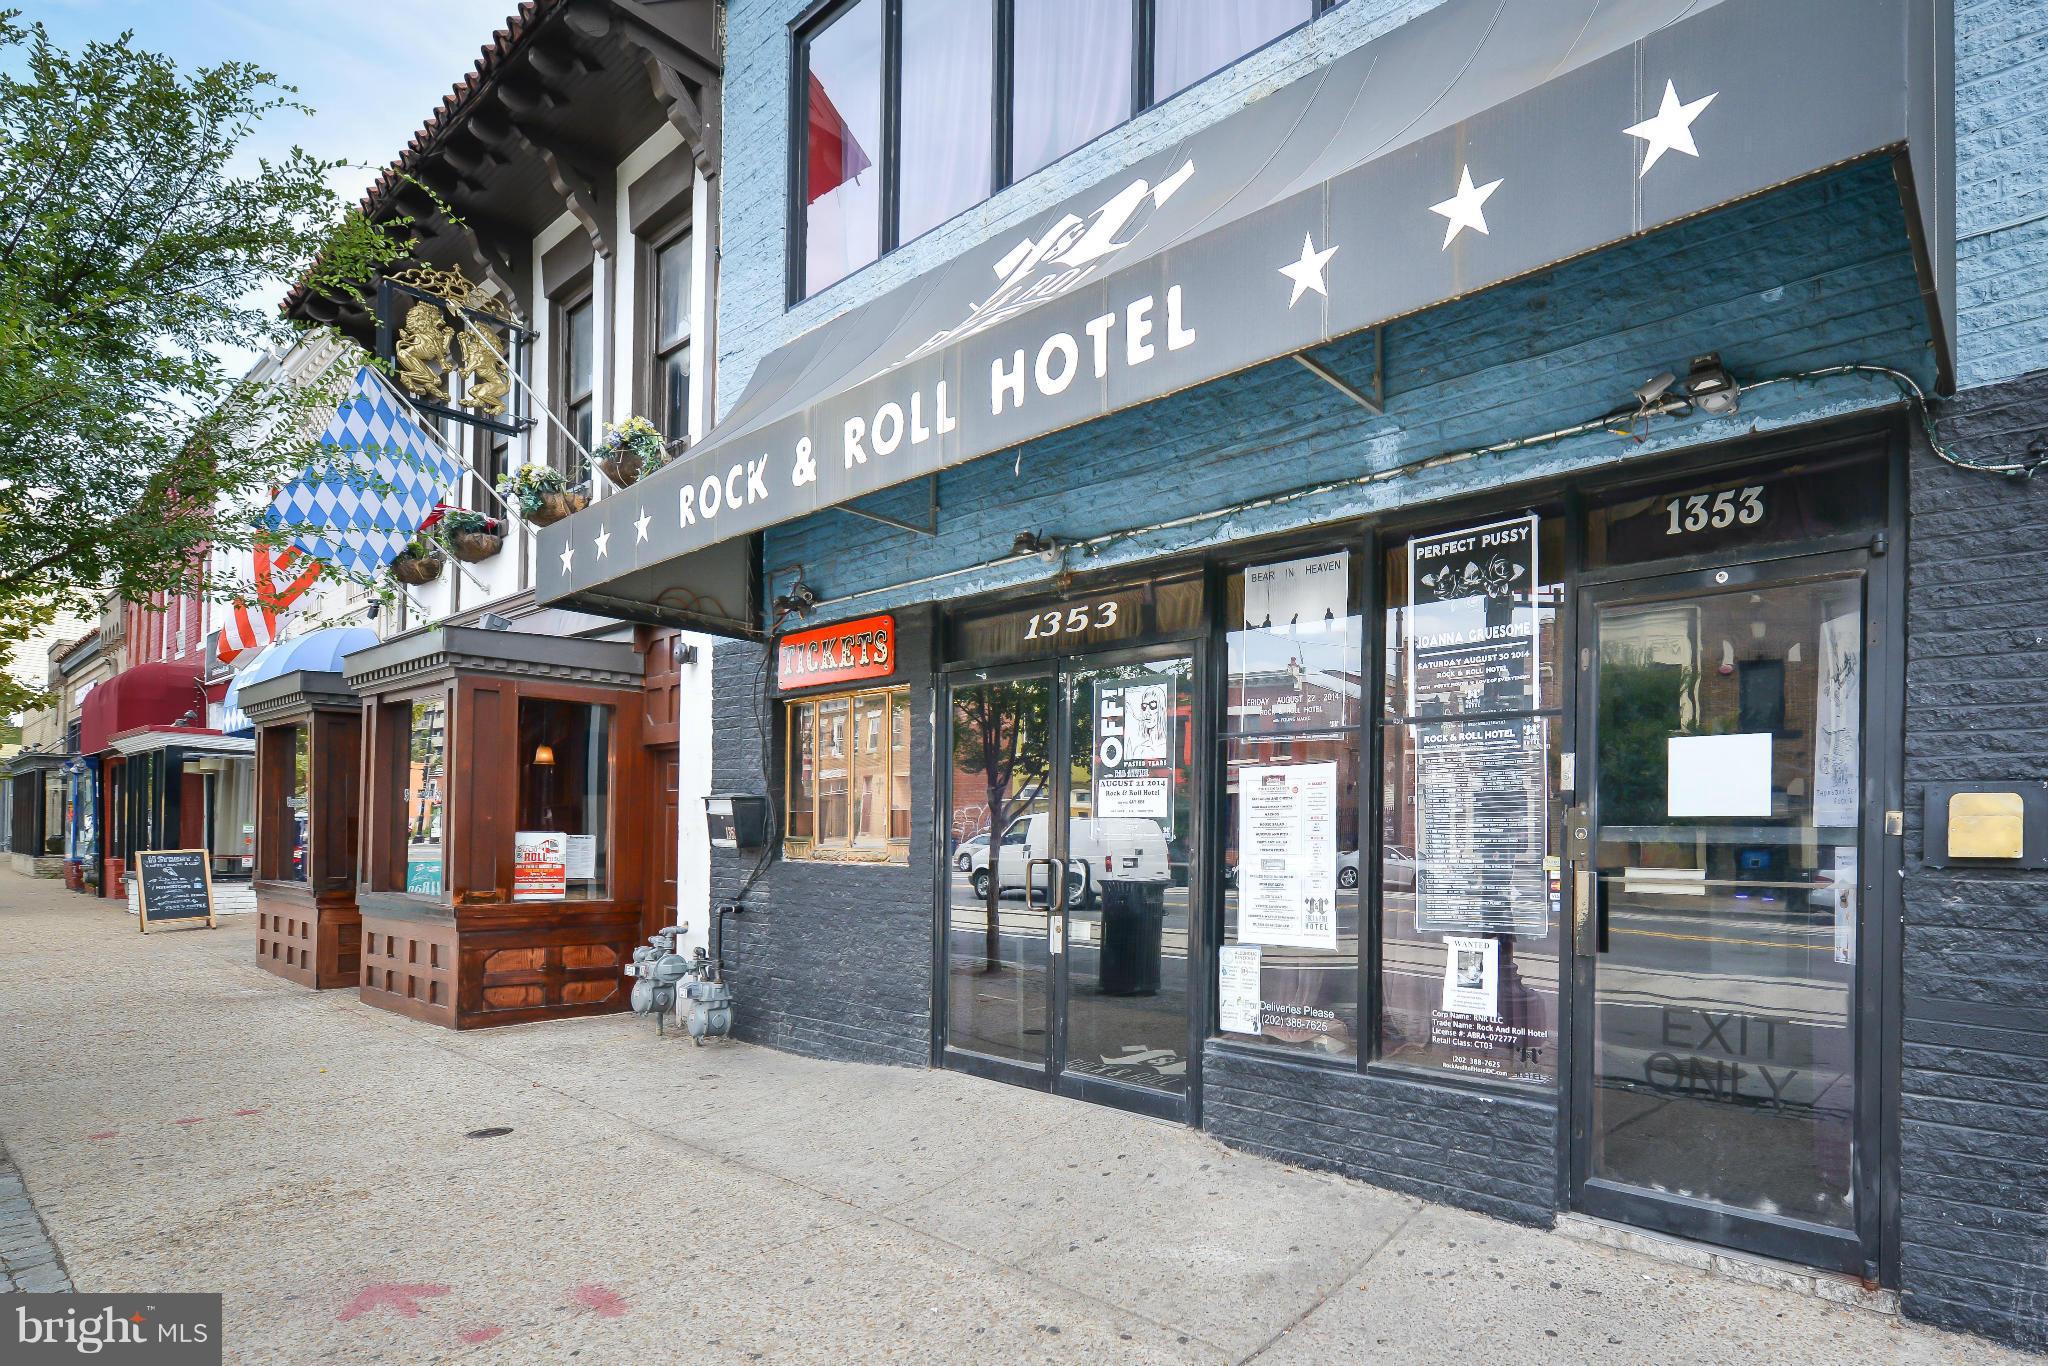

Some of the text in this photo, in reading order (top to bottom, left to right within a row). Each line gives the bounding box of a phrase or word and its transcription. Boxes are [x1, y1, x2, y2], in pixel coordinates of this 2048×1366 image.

[678, 453, 769, 529] ROCK
[791, 435, 817, 488] &
[844, 379, 957, 470] ROLL
[990, 284, 1197, 416] HOTEL
[1665, 485, 1765, 535] 1353
[1416, 525, 1530, 560] PERFECT PUSSY
[1251, 559, 1341, 582] BEAR IN HEAVEN
[1023, 601, 1118, 641] 1353
[1415, 621, 1531, 649] JOANNA GRUESOME
[781, 629, 889, 677] TICKETS
[1417, 650, 1531, 670] SATURDAY AUGUST 30 2014
[1436, 670, 1456, 679] ROCK
[1465, 667, 1484, 676] ROLL
[1485, 665, 1509, 674] HOTEL
[1246, 697, 1270, 707] FRIDAY
[1276, 694, 1303, 705] AUGUST
[1323, 692, 1340, 702] 2014
[1303, 705, 1323, 713] HOTEL
[1100, 687, 1124, 769] OFF!
[1423, 728, 1516, 744] ROCK & ROLL HOTEL
[1100, 780, 1134, 788] AUGUST
[1454, 940, 1490, 949] WANTED
[1259, 1000, 1302, 1015] Deliveries
[1303, 1005, 1335, 1019] Please
[1432, 1009, 1449, 1019] Corp
[1450, 1011, 1472, 1021] Name:
[1489, 1015, 1504, 1024] LLC
[1261, 1014, 1284, 1028] (202)
[1285, 1016, 1328, 1032] 388-7625
[1432, 1018, 1548, 1038] Trade Name: Rock And Roll Hotel
[1432, 1027, 1457, 1037] License
[1466, 1031, 1518, 1044] ABRA-072777
[1432, 1035, 1493, 1050] Retail Class: CT03
[1662, 1007, 1791, 1059] EXIT
[1469, 1057, 1501, 1068] 388-7625
[1644, 1052, 1798, 1112] ONLY
